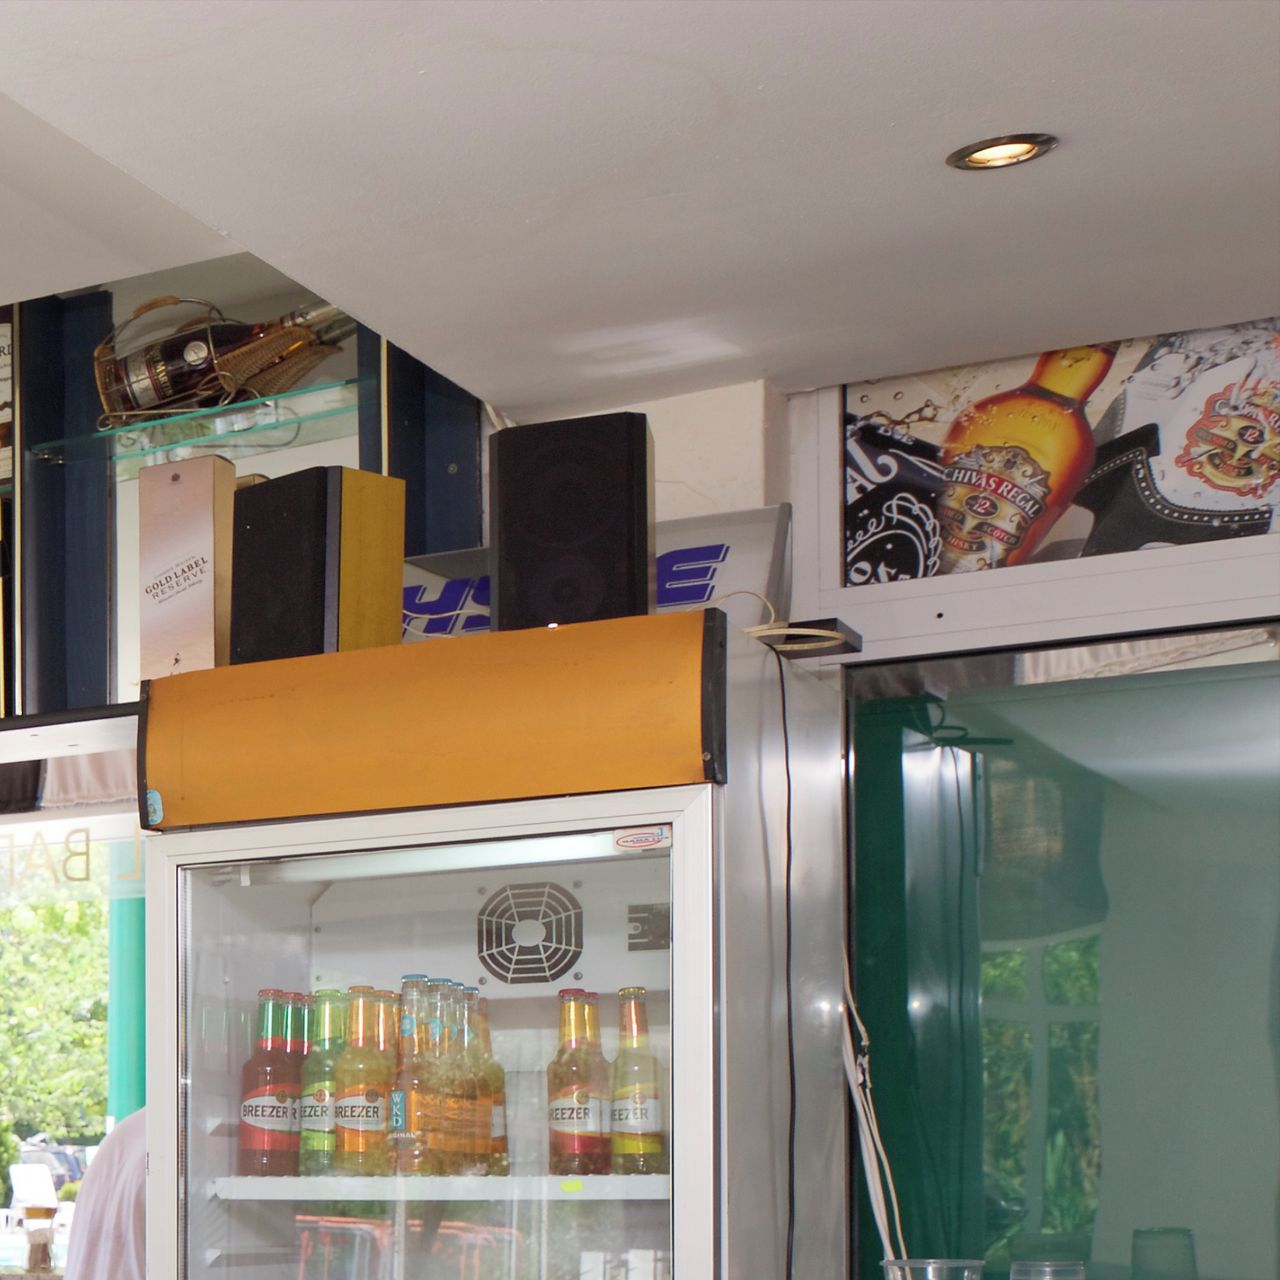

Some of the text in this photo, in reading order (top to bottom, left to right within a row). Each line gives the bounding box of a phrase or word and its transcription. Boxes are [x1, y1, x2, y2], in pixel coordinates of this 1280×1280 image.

[943, 466, 1000, 495] CHIVAS
[997, 479, 1041, 518] REGAL
[145, 575, 172, 595] GOLD
[174, 556, 208, 579] LABEL
[242, 1104, 289, 1119] BREEZER
[549, 1106, 591, 1121] REEZER
